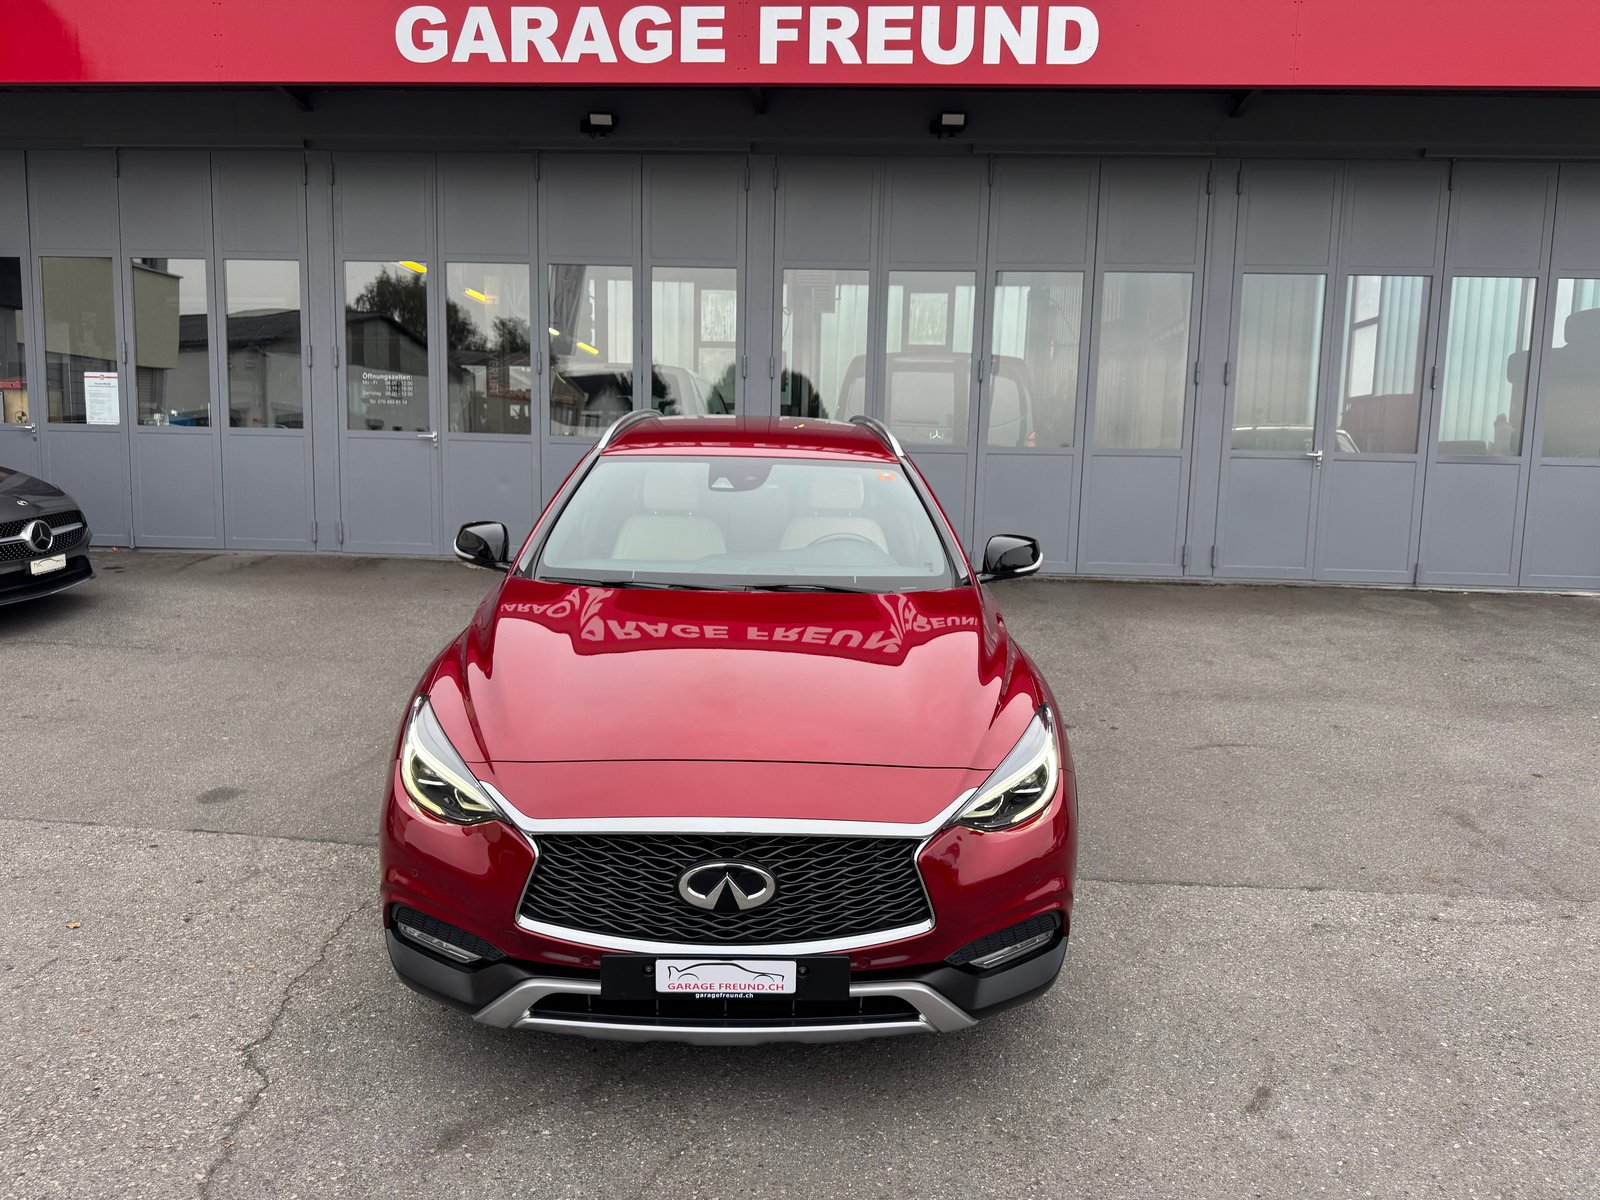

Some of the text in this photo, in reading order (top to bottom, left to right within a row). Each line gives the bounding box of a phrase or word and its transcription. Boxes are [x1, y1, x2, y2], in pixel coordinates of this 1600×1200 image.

[395, 5, 1099, 65] GARAGE FREUND
[362, 372, 413, 380] Öffnungszeiten:
[667, 983, 785, 991] GARAGE FREUND.CH
